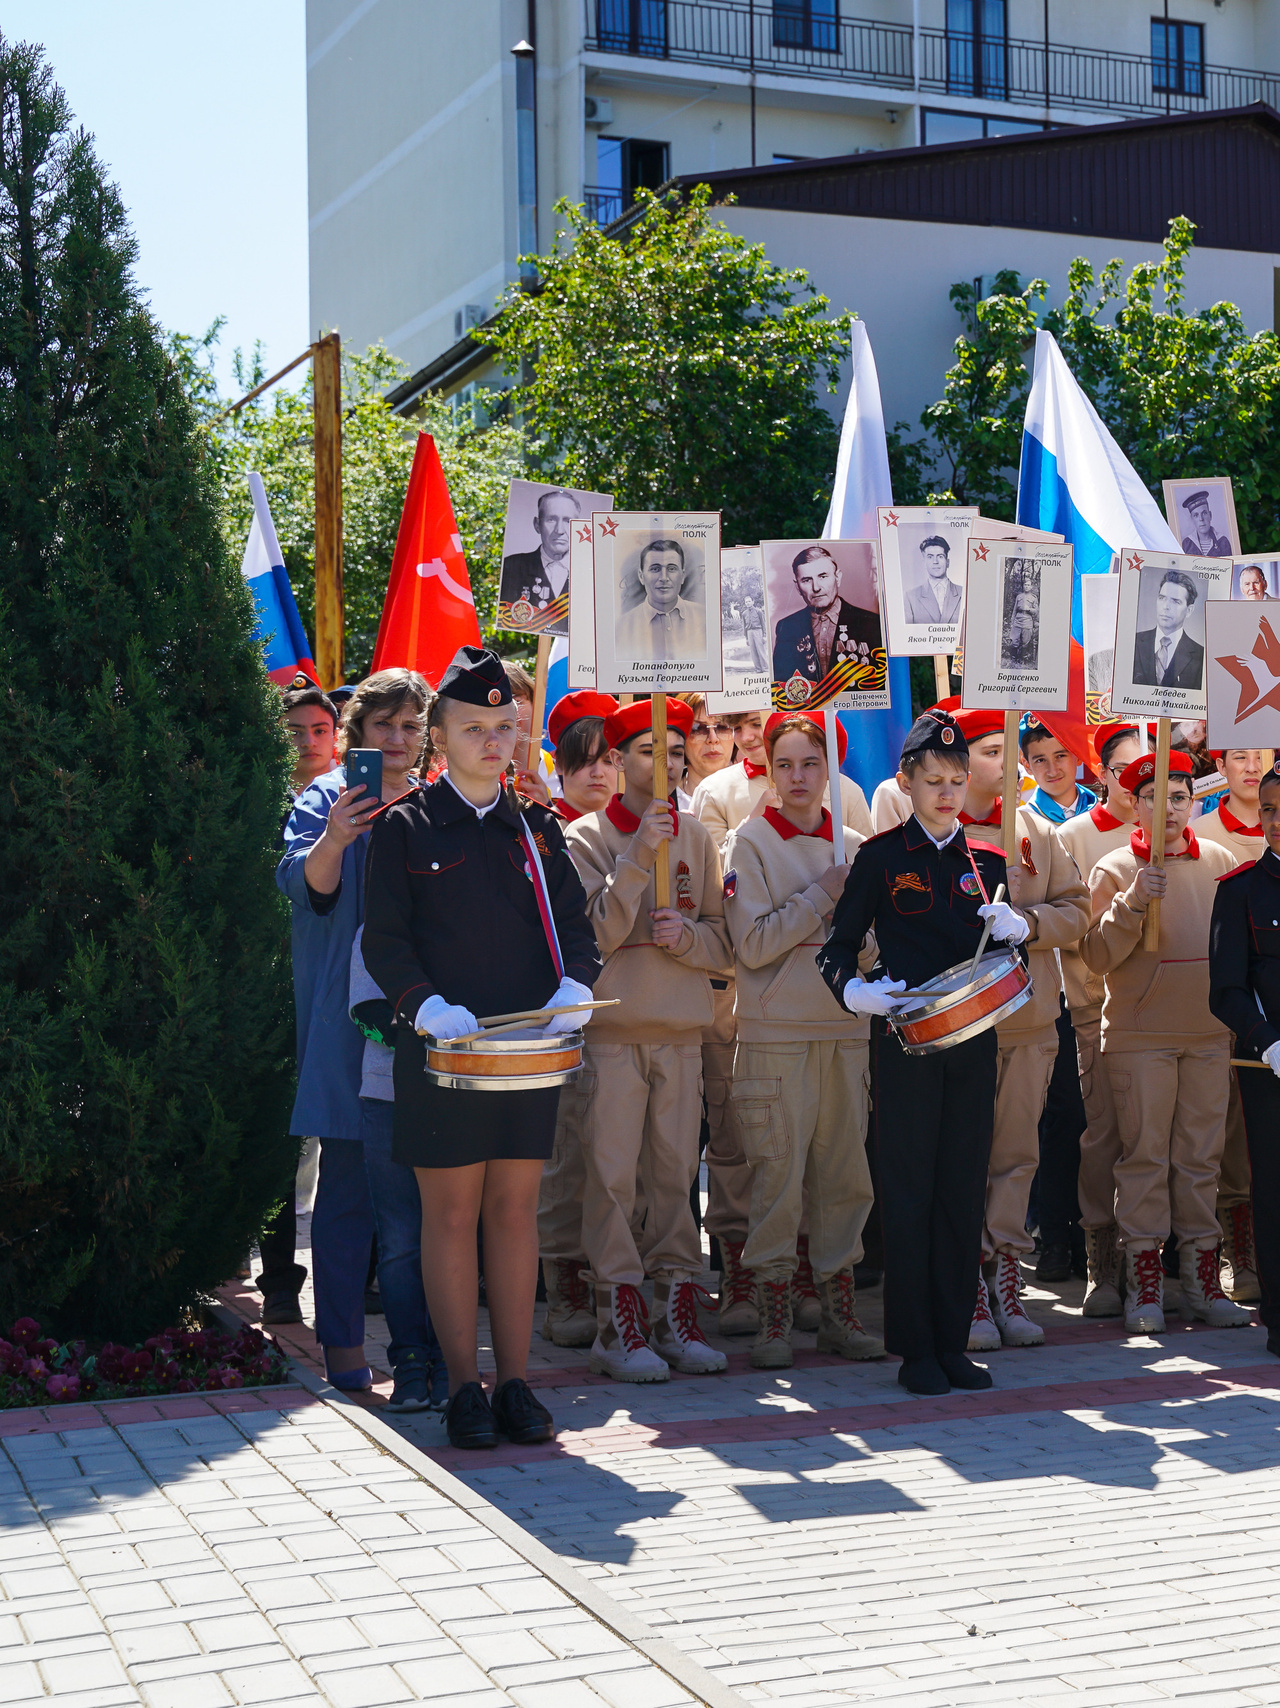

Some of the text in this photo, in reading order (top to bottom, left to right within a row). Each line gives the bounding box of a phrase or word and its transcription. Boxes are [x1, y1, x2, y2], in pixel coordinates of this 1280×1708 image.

[682, 530, 707, 538] ПОЛК
[1041, 559, 1062, 567] ПОЛК
[1198, 572, 1220, 581] ПОЛК
[928, 636, 957, 644] Григор
[632, 662, 695, 671] Попандопуло
[618, 673, 710, 683] Кузьма Георгиевич
[997, 673, 1039, 682] Борисенко
[723, 687, 760, 698] Алексей
[978, 684, 1057, 693] Григорий Сергеевич
[1151, 688, 1186, 698] Лебедев
[1122, 697, 1160, 706] Николай
